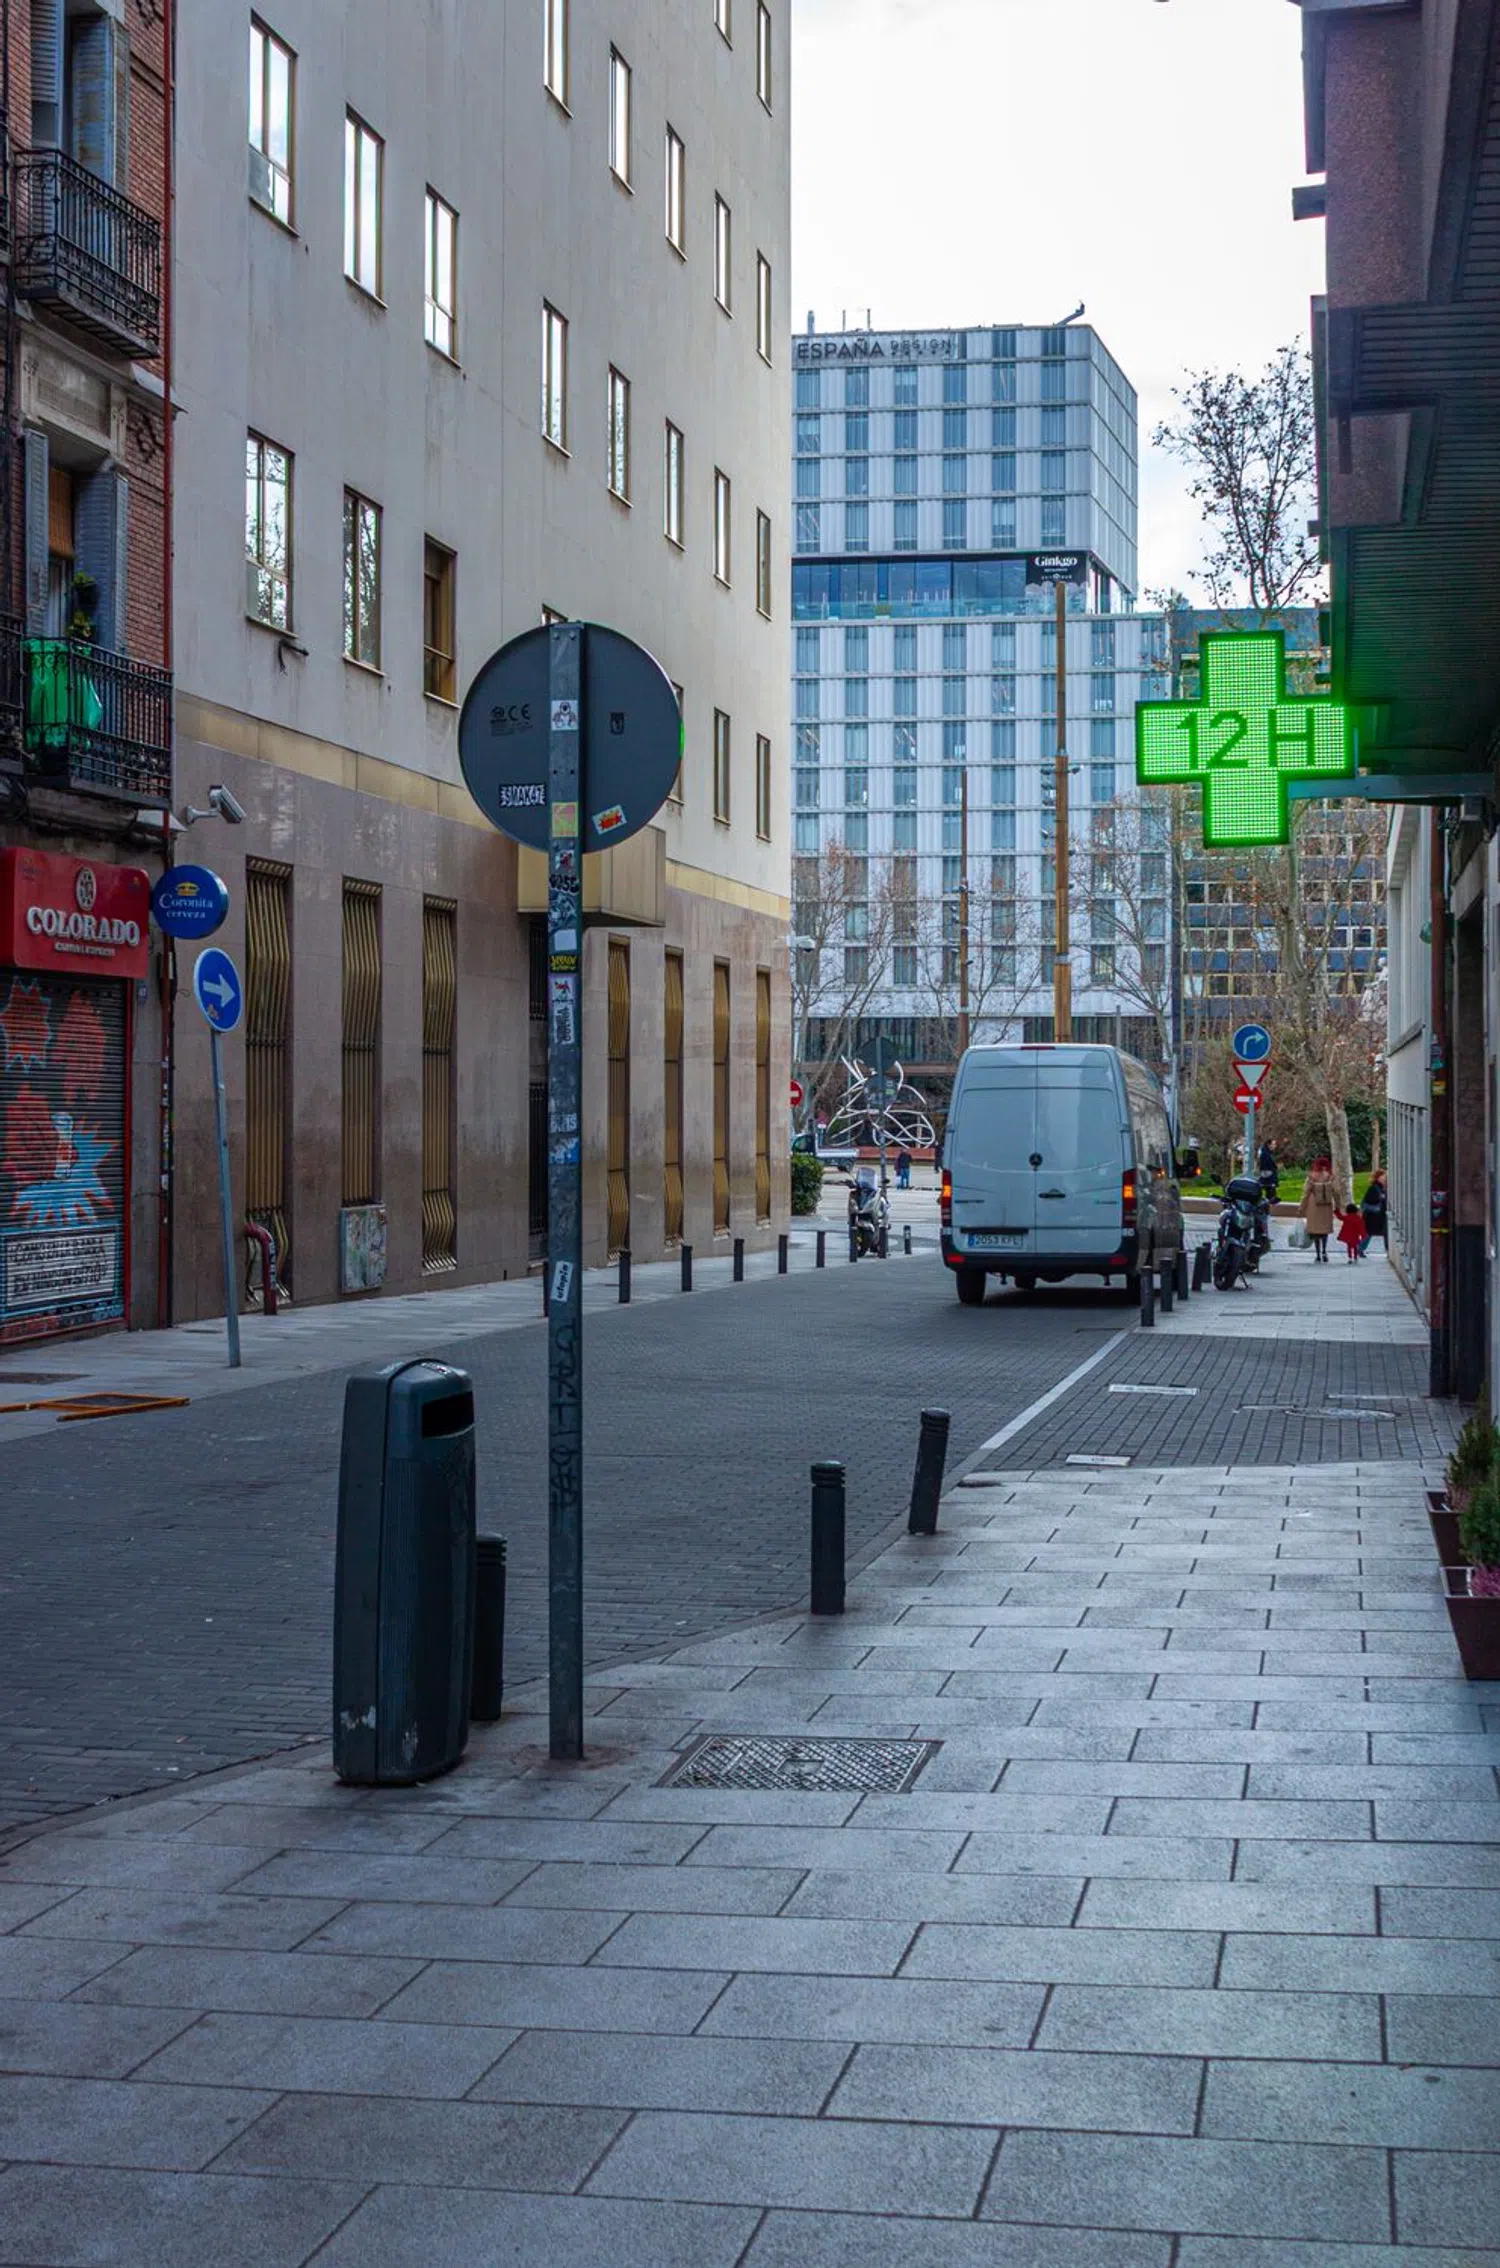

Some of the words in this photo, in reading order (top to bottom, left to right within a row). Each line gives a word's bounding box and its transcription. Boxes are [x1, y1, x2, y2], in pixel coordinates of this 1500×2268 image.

[797, 338, 884, 359] ESPAÑA
[890, 339, 951, 350] DESIGN
[1034, 556, 1078, 567] Ginkgo
[1175, 707, 1316, 770] 12H
[158, 893, 213, 909] Coronita
[166, 910, 206, 919] cerveza
[27, 906, 141, 946] COLORADO
